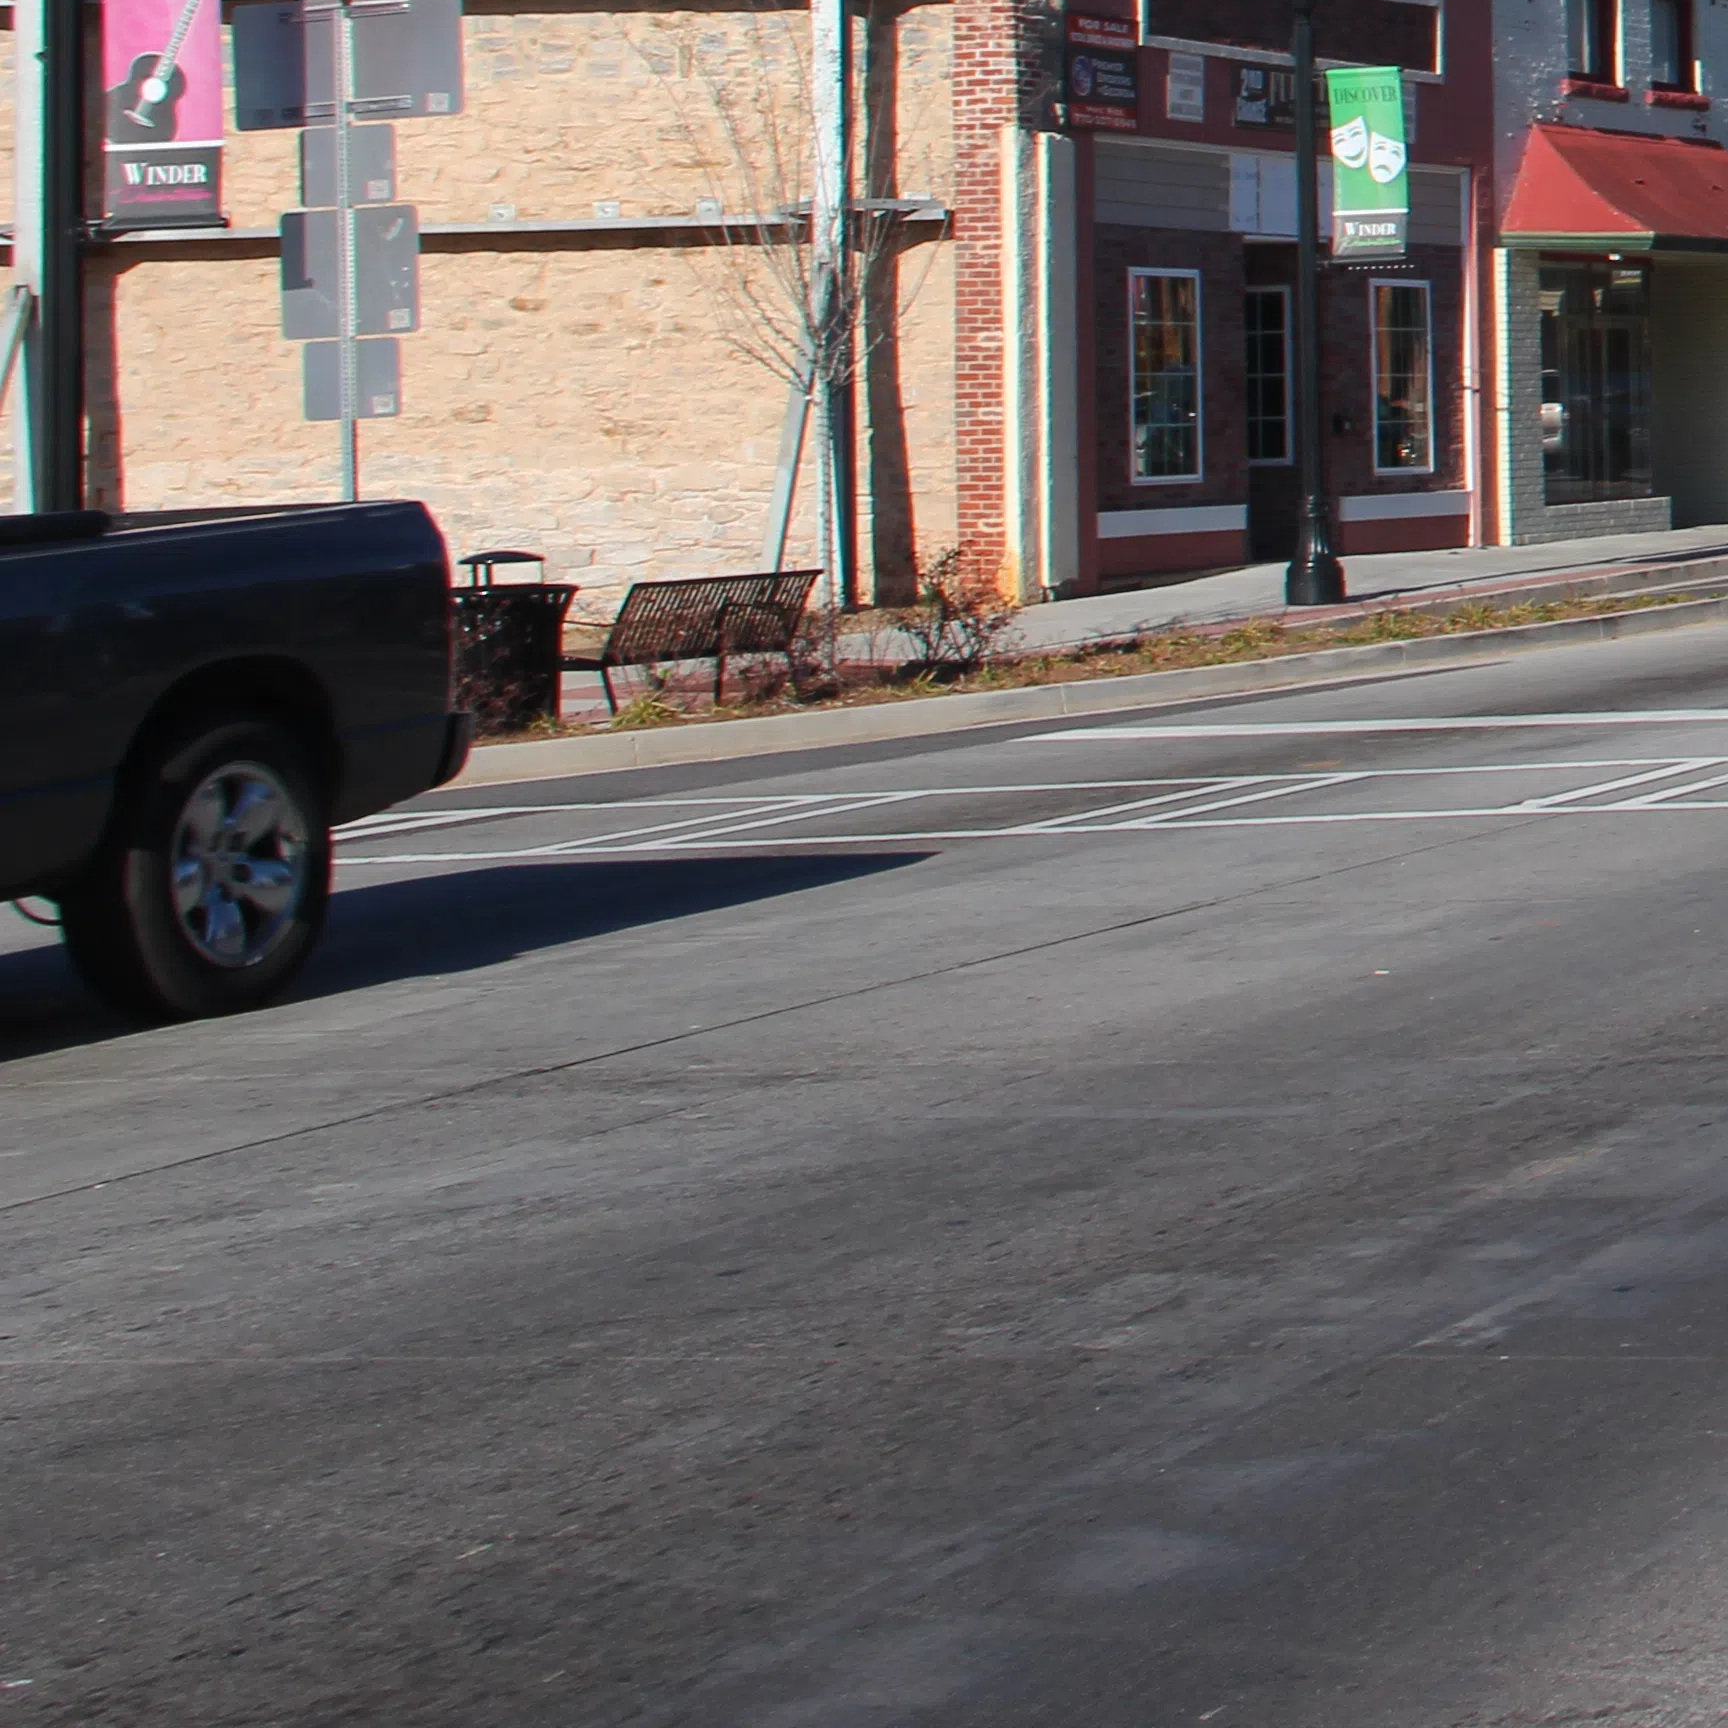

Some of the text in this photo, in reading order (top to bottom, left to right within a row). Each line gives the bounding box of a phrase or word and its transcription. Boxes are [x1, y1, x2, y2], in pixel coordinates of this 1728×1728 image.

[1333, 85, 1398, 105] DISCOVER
[122, 161, 208, 186] WINDER
[1343, 221, 1397, 237] WINDER
